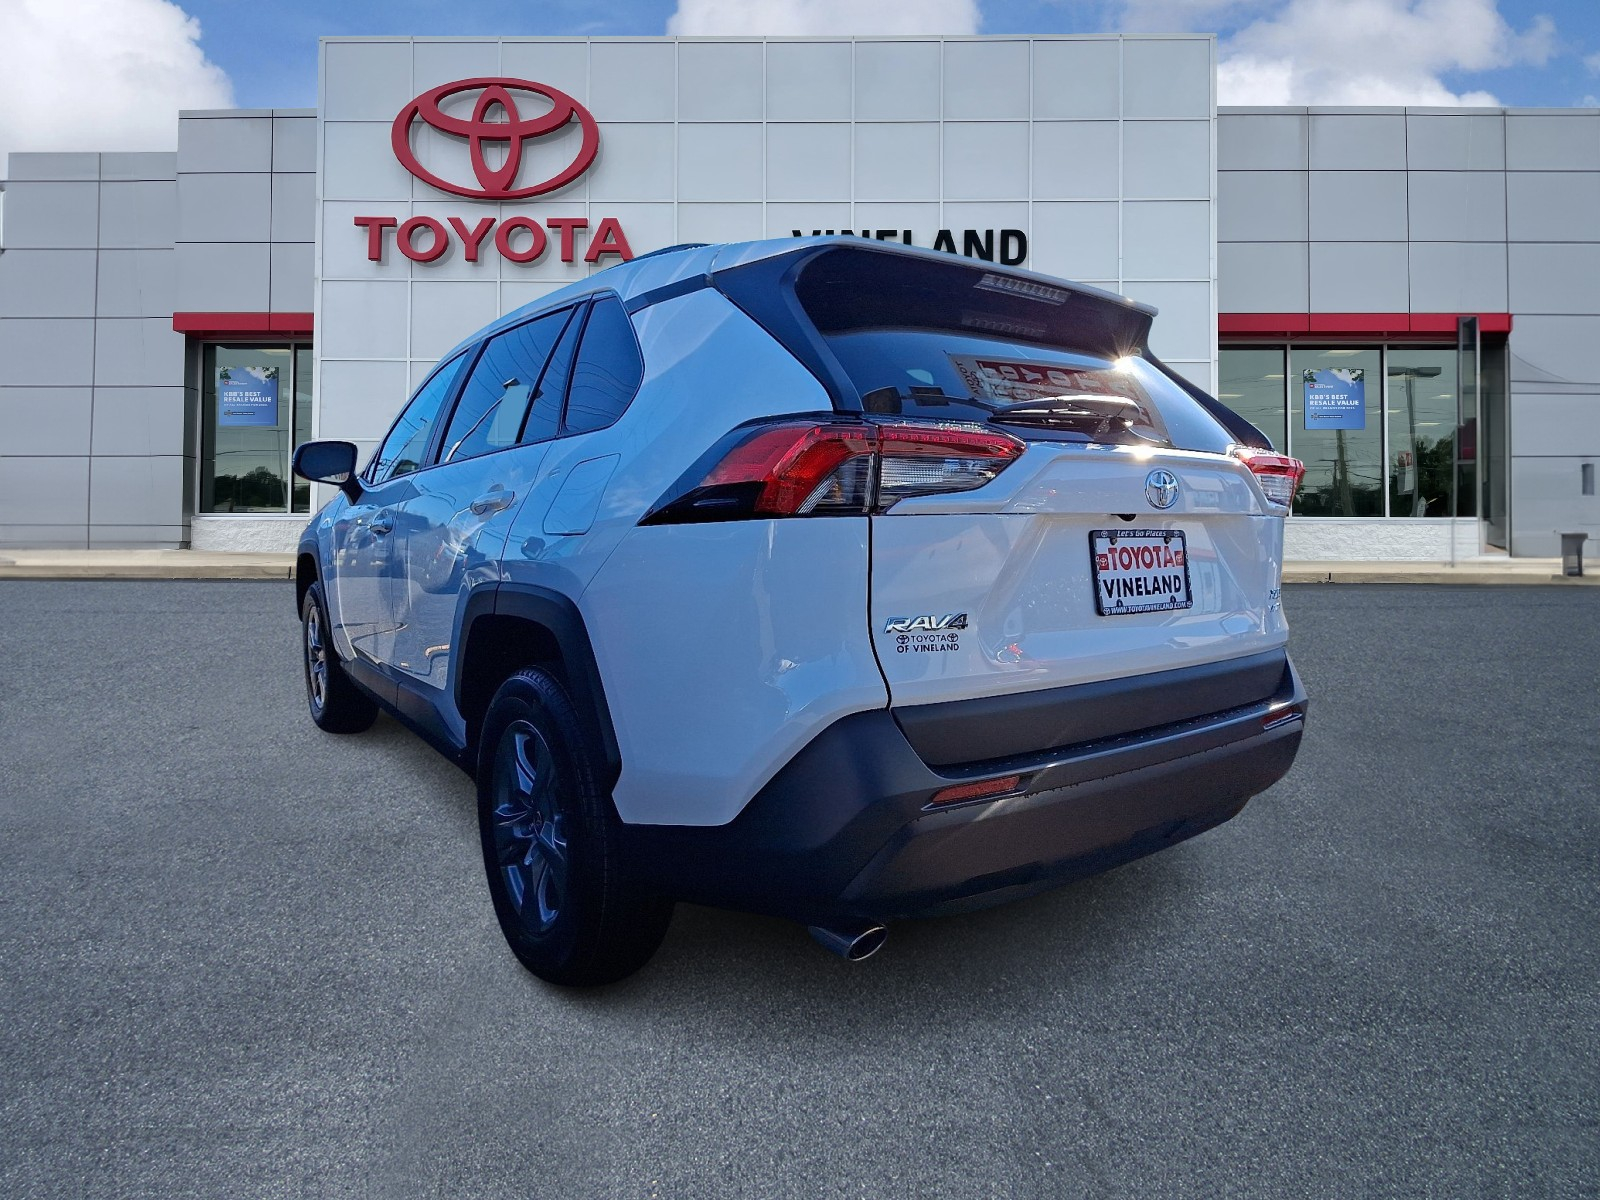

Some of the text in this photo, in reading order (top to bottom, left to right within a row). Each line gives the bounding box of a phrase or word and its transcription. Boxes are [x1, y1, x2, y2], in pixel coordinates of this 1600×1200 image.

[354, 216, 634, 263] TOYOTA
[1107, 545, 1176, 571] TOYOTA
[1102, 574, 1182, 599] VINELAND
[1111, 601, 1187, 614] WWW.TOYOTAVINELAND.COM
[884, 612, 968, 633] RAV4
[896, 643, 959, 653] OF VINELAND
[911, 634, 948, 643] TOYOTA
